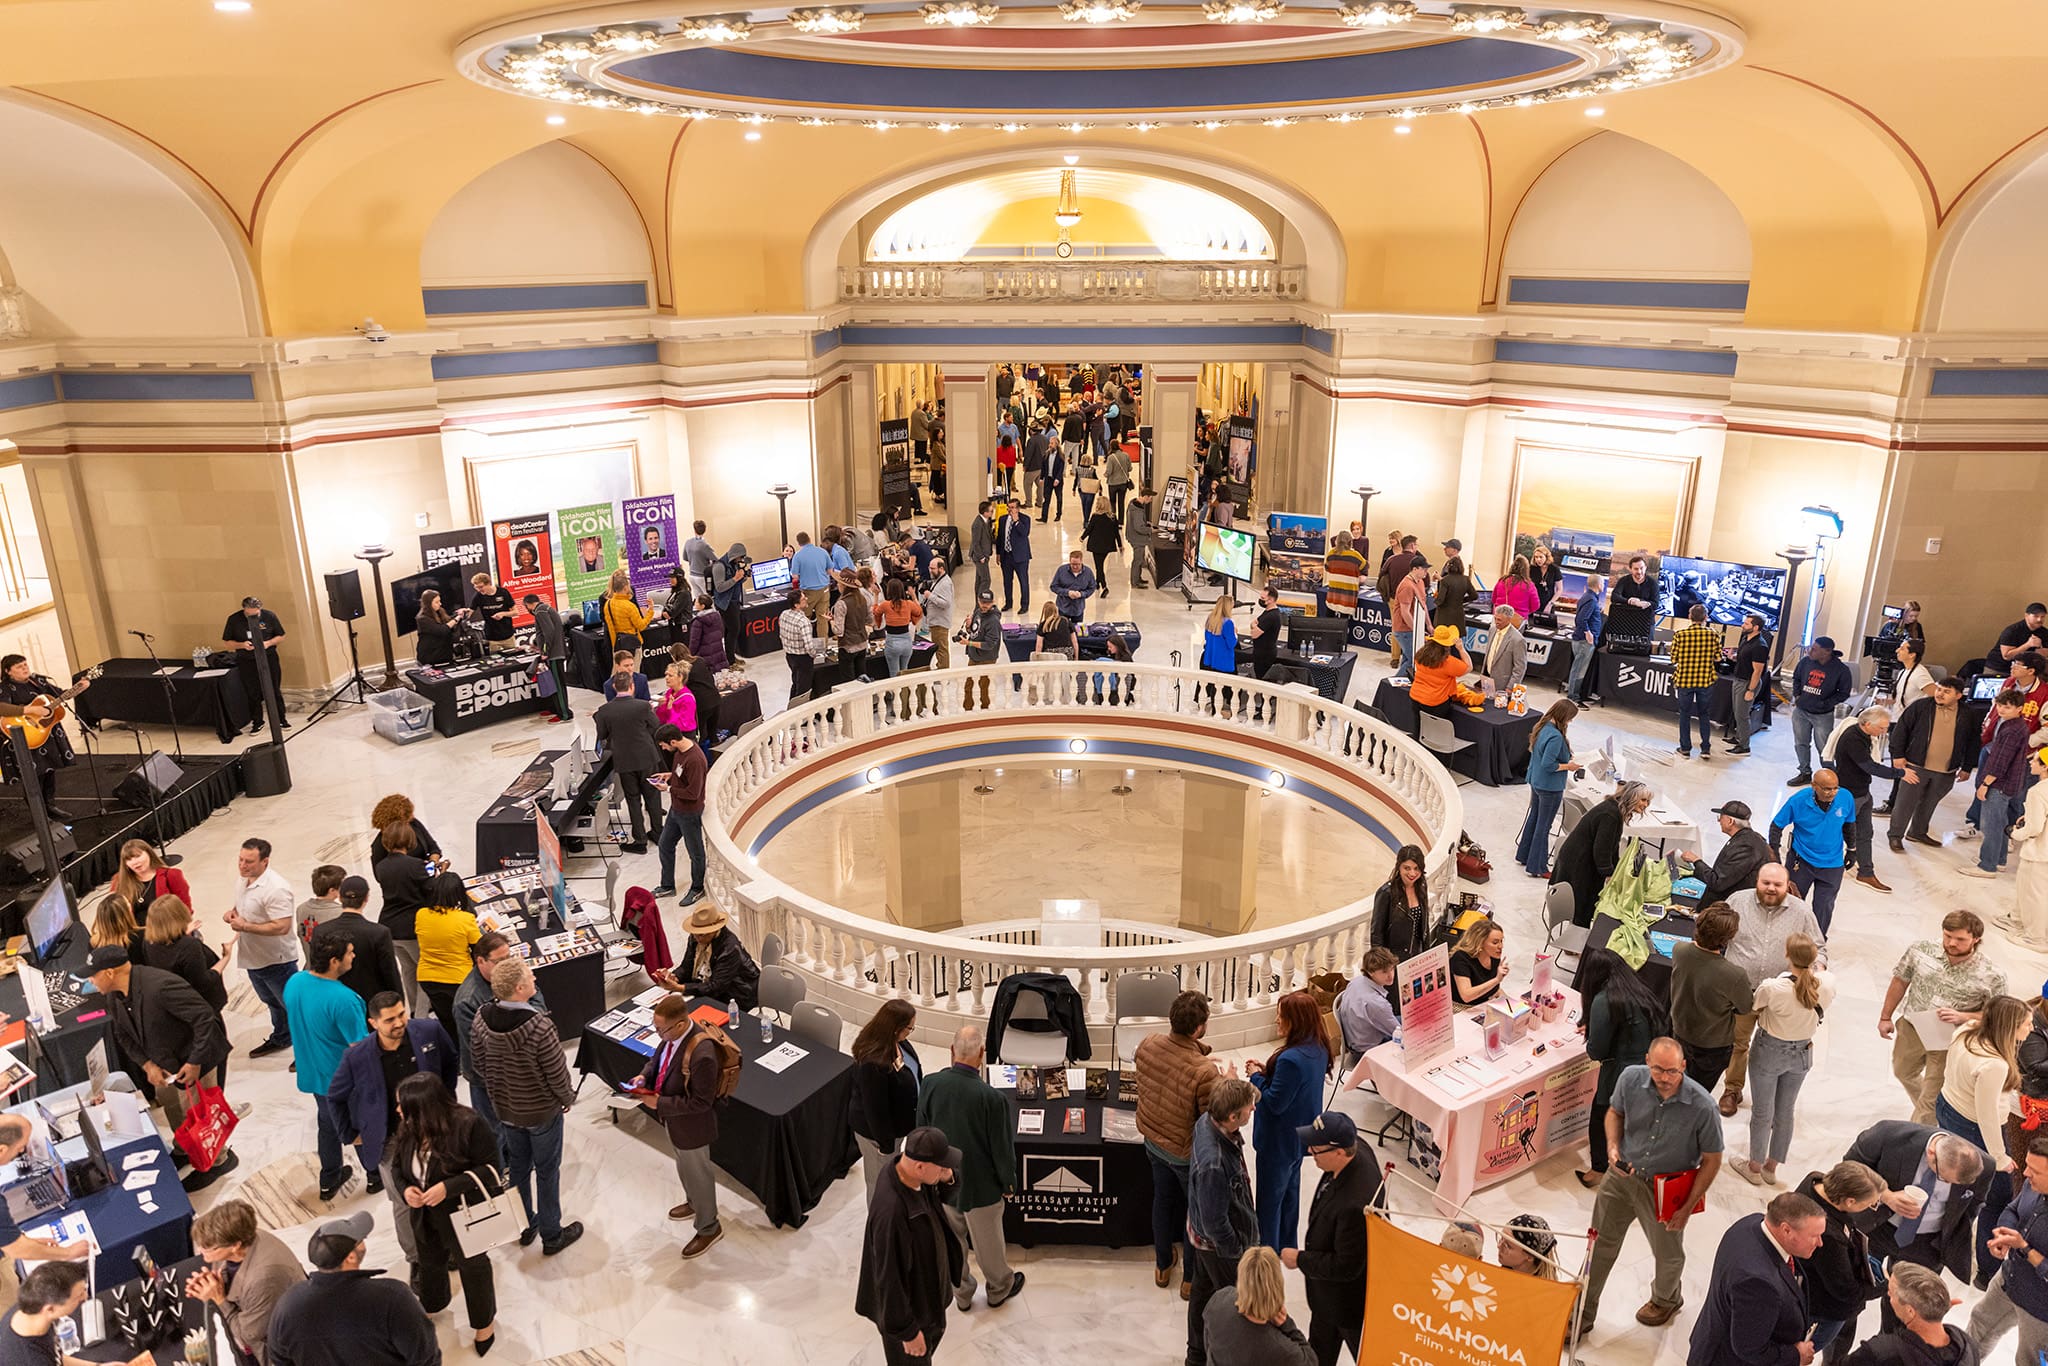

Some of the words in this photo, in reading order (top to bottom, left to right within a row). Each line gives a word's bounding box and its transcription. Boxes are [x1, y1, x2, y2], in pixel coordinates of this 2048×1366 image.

[625, 500, 659, 510] oklahoma
[560, 510, 596, 521] oklahoma
[625, 505, 674, 525] ICON
[510, 520, 548, 530] deadCenter
[561, 515, 613, 537] ICON
[426, 543, 484, 560] BOILING
[503, 579, 520, 588] Alfre
[520, 573, 553, 585] Woodard
[1353, 606, 1384, 626] ULSA
[745, 615, 779, 637] retr
[1526, 642, 1547, 655] LM
[455, 670, 532, 701] BOILIN
[1644, 668, 1673, 698] ONE
[779, 1046, 801, 1058] R27
[1007, 1195, 1071, 1206] CHICKASAW
[1077, 1196, 1119, 1206] NATION
[1020, 1205, 1107, 1214] PRODUCTIONS
[1392, 1303, 1528, 1366] OKLAHOMA
[1414, 1332, 1445, 1353] Film
